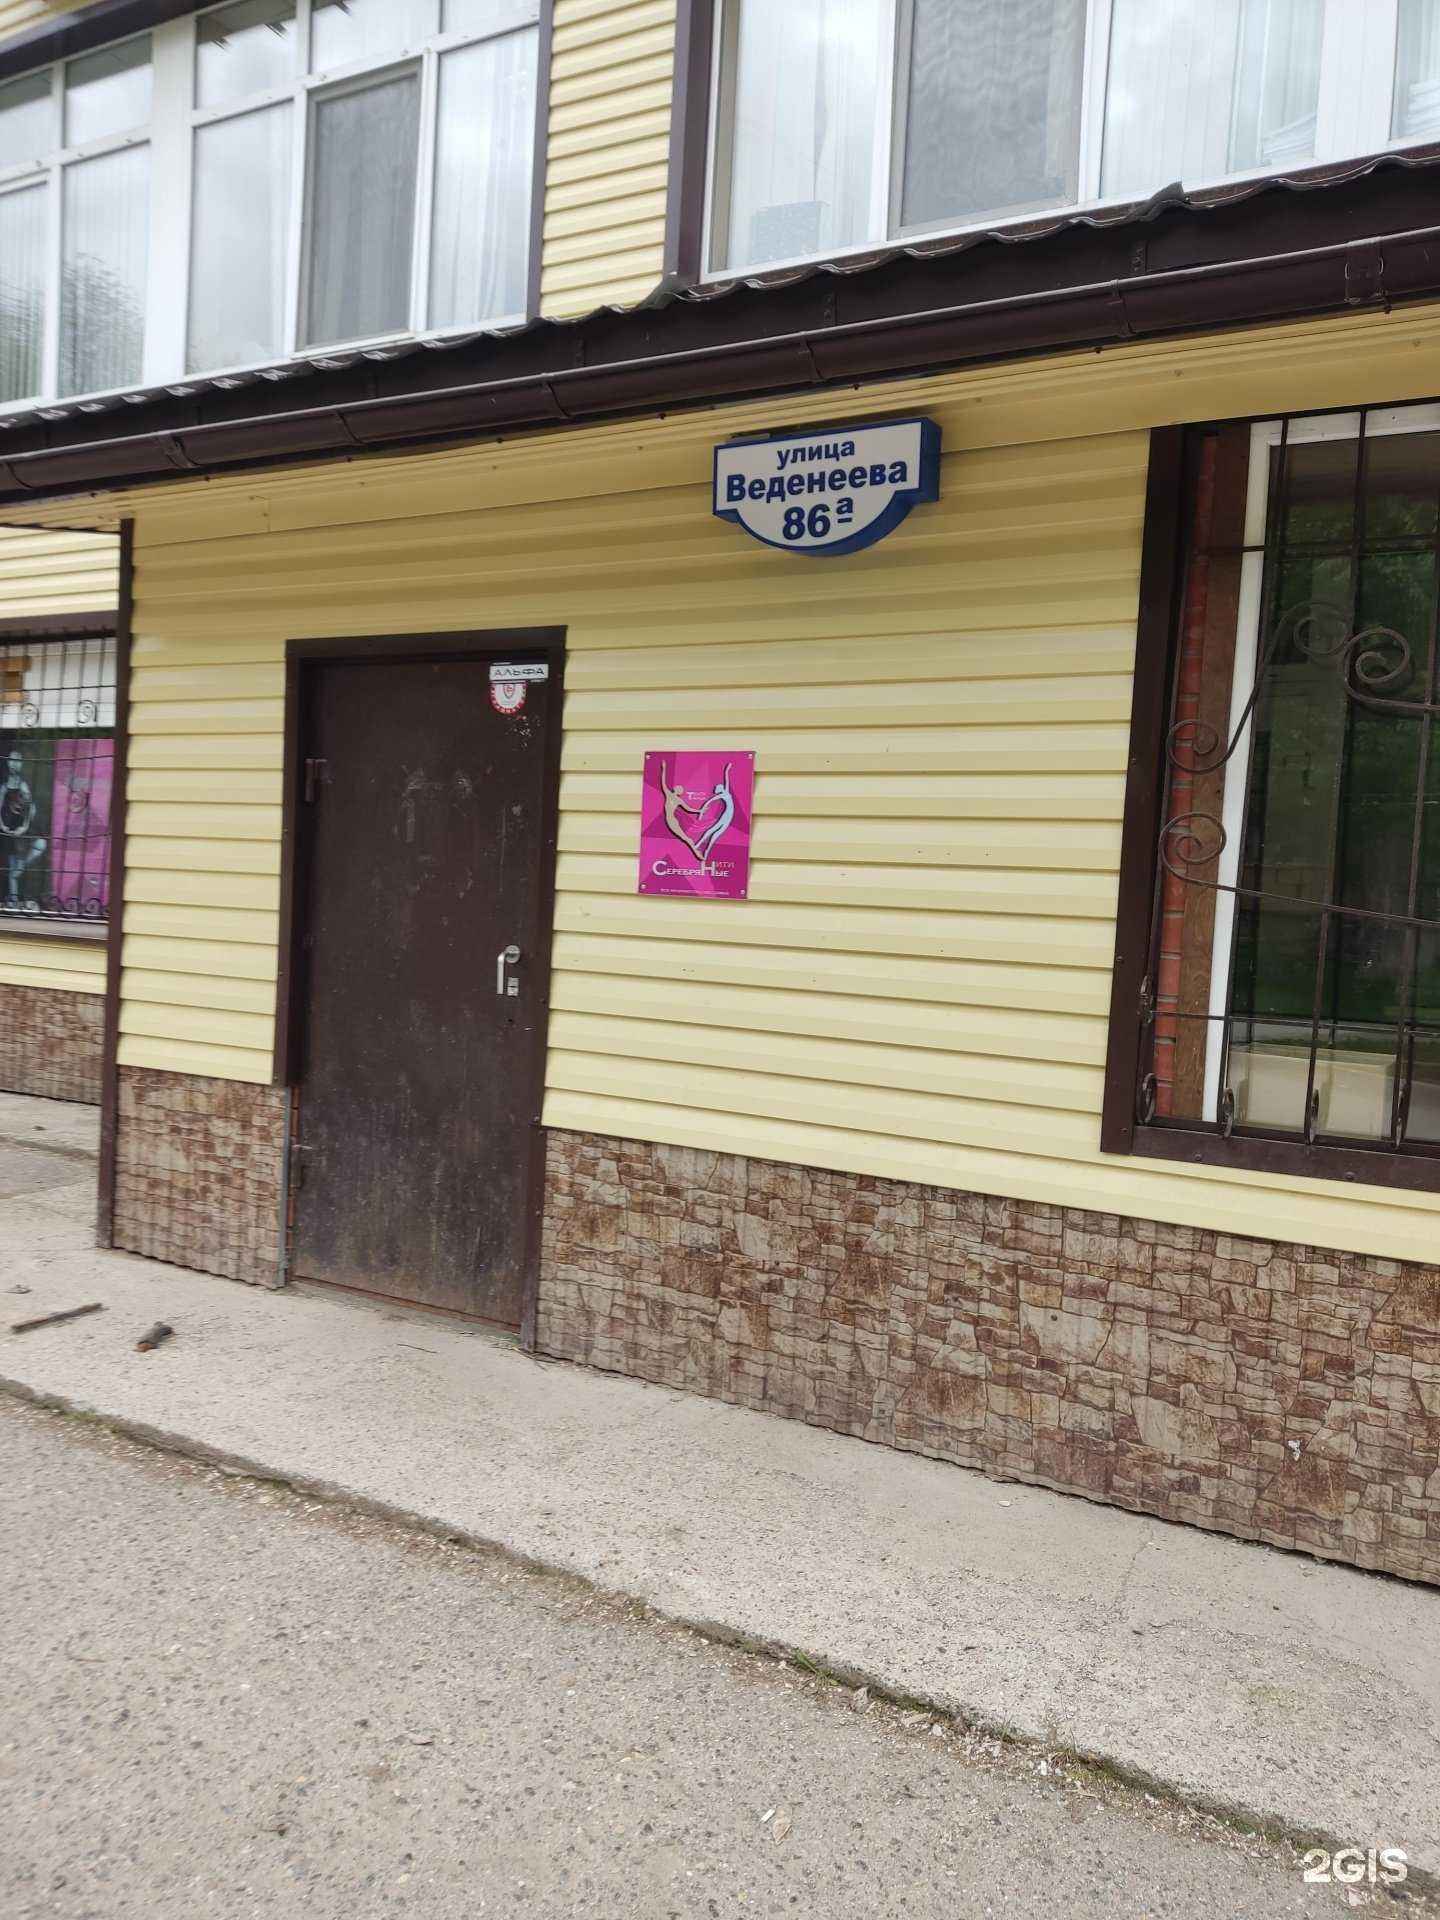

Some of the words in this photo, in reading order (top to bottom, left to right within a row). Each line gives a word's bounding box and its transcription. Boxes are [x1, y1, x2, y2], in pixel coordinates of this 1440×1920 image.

[777, 440, 856, 470] улица
[727, 460, 907, 503] Веденеева
[494, 667, 545, 676] АЛЬФА
